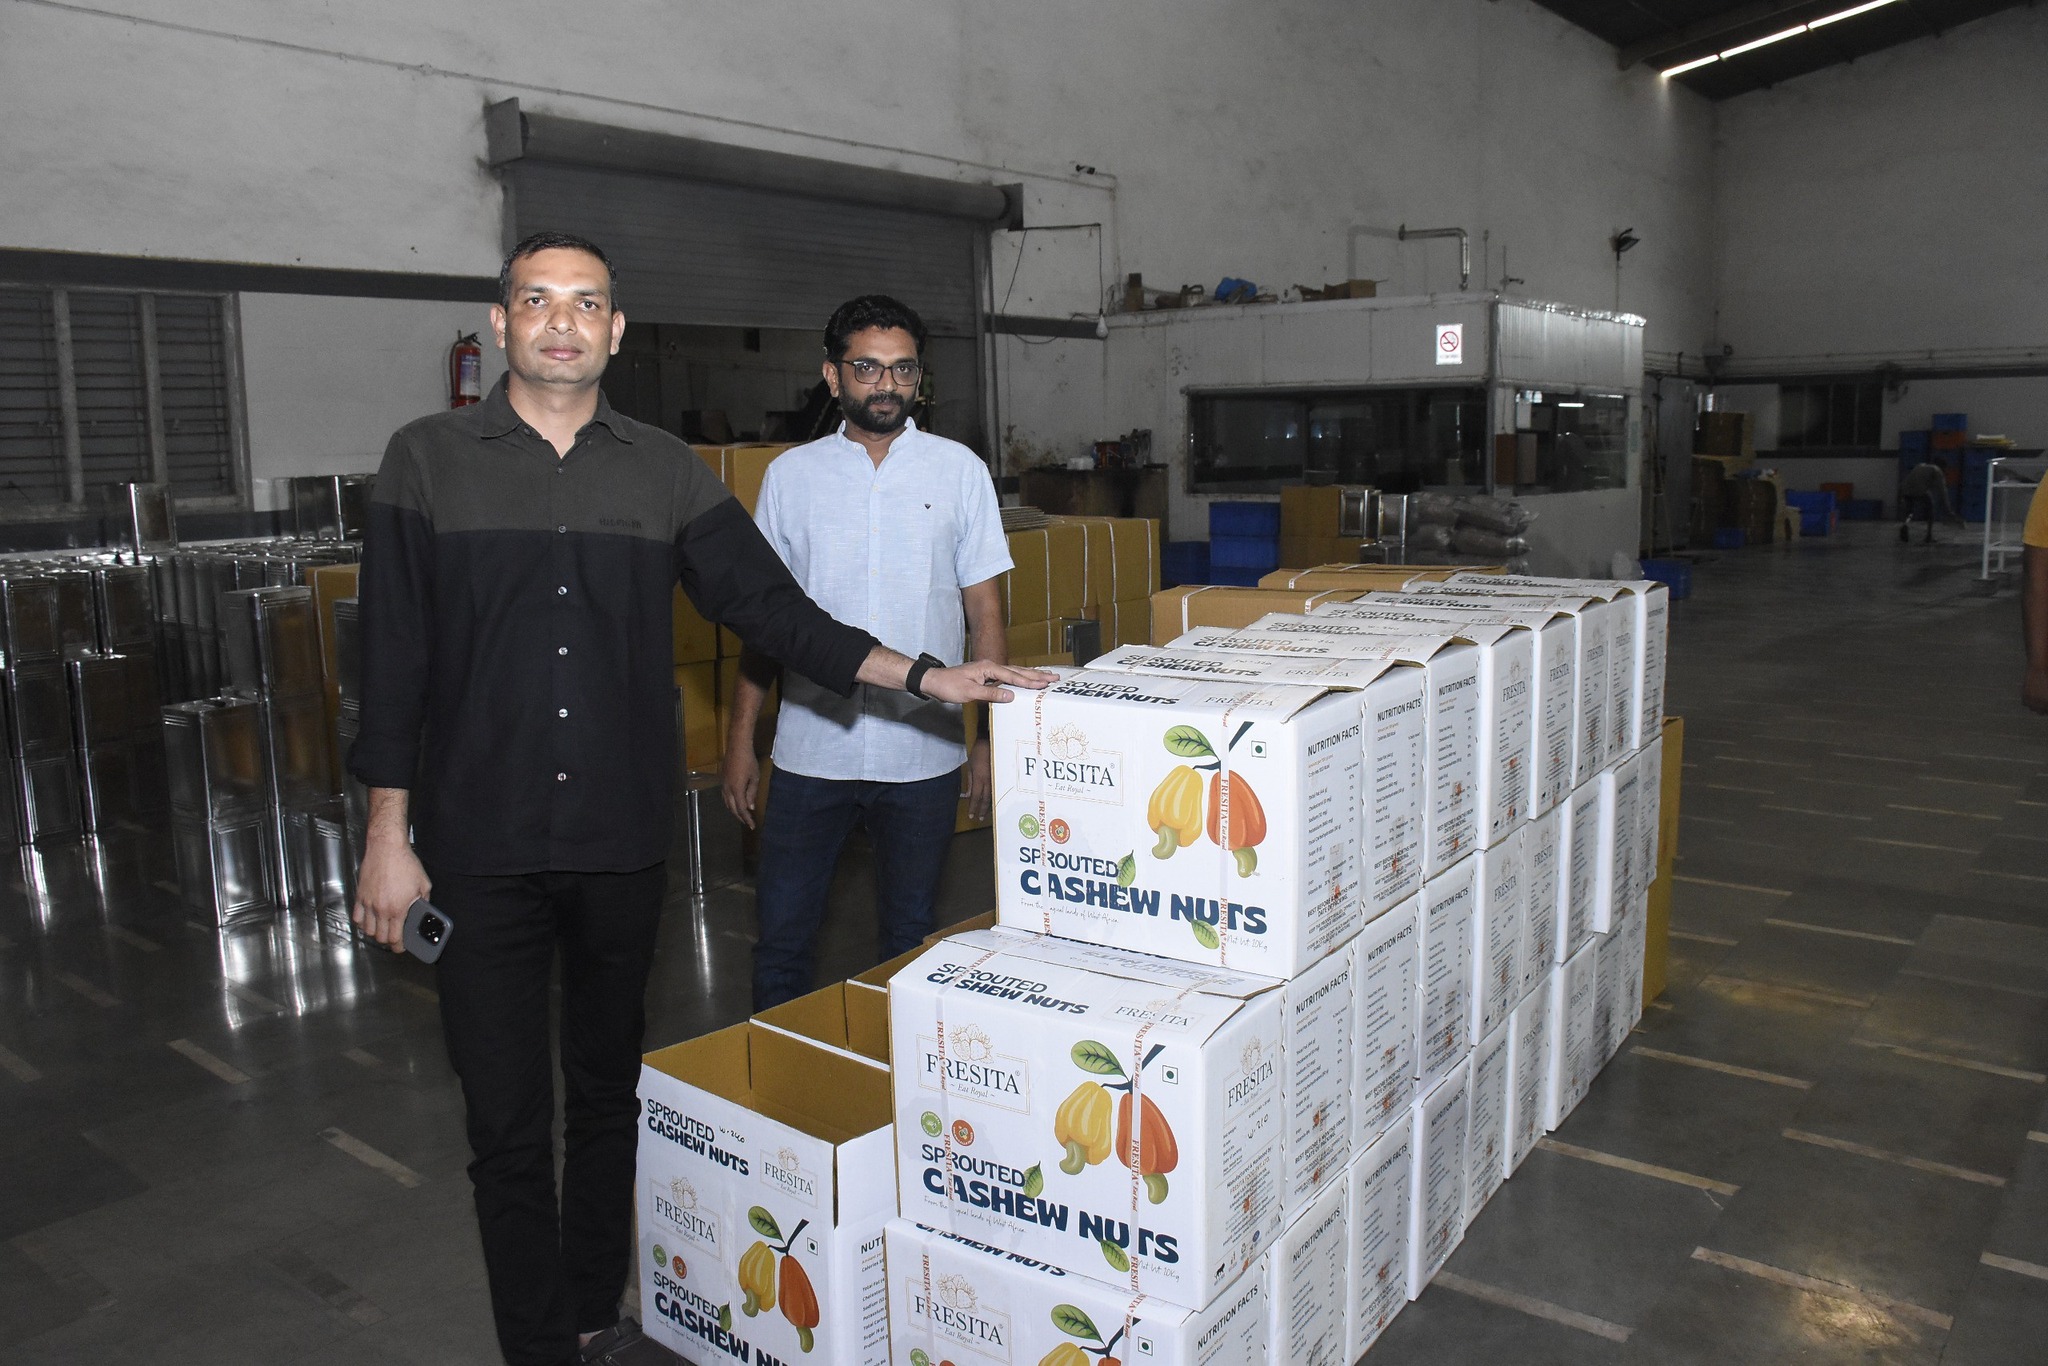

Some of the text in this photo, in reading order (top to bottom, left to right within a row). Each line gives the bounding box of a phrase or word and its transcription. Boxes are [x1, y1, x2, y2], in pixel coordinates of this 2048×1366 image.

[1201, 635, 1293, 646] SPROUTED
[1280, 644, 1330, 654] NUTS
[1125, 654, 1224, 667] SPROUTED
[1205, 666, 1262, 677] NUTS
[1285, 669, 1351, 679] FREITA
[1051, 686, 1180, 705] SHEW NUTS
[1205, 696, 1274, 707] FREITA
[1438, 675, 1476, 697] NUTRITION FACTS
[1034, 691, 1047, 727] FRESITA
[1377, 697, 1422, 723] NUTRITION FACTS
[1308, 724, 1360, 757] NUTRITION FACTS
[1054, 782, 1084, 795] Eat Royal
[1019, 846, 1119, 878] SPROUTED
[1020, 869, 1268, 935] CASHEW NUTS
[1036, 901, 1044, 911] the
[1080, 910, 1086, 921] of
[1220, 897, 1228, 937] FRESITA
[1430, 886, 1469, 917] NUTRITION FACTS
[1368, 924, 1412, 962] NUTRITION FACTS
[926, 973, 1090, 1014] CASHEW NUTS
[937, 963, 1048, 993] SPROUTED
[1296, 970, 1348, 1016] NUTRITION FACTS
[937, 1020, 946, 1061] FRESITA
[1134, 1022, 1154, 1058] FRESITA
[958, 1084, 988, 1098] Eat Royal
[1228, 1060, 1274, 1108] FRESITA
[648, 1098, 714, 1142] SPROUTED
[648, 1116, 750, 1176] CASHEW NUTS
[944, 1134, 952, 1172] FRESITA
[1132, 1138, 1140, 1181] FRESITA
[764, 1162, 814, 1196] FRESITA
[922, 1144, 1026, 1188] SPROUTED
[1364, 1143, 1408, 1188] NUTRITION FACTS
[656, 1195, 716, 1243] FRESITA
[923, 1168, 1180, 1264] CASHEW NUTS
[924, 1196, 938, 1206] From
[939, 1200, 948, 1210] the
[986, 1216, 992, 1226] of
[1292, 1228, 1324, 1264] NUTRITION
[1324, 1206, 1341, 1232] FACTS
[862, 1261, 879, 1273] Calories
[922, 1254, 932, 1292] FRESITA
[654, 1271, 720, 1320] SPROUTED
[654, 1292, 750, 1364] CASHEW
[1197, 1305, 1236, 1351] NUTRITION
[1237, 1284, 1258, 1312] FACTS
[944, 1327, 974, 1345] Eat Royal
